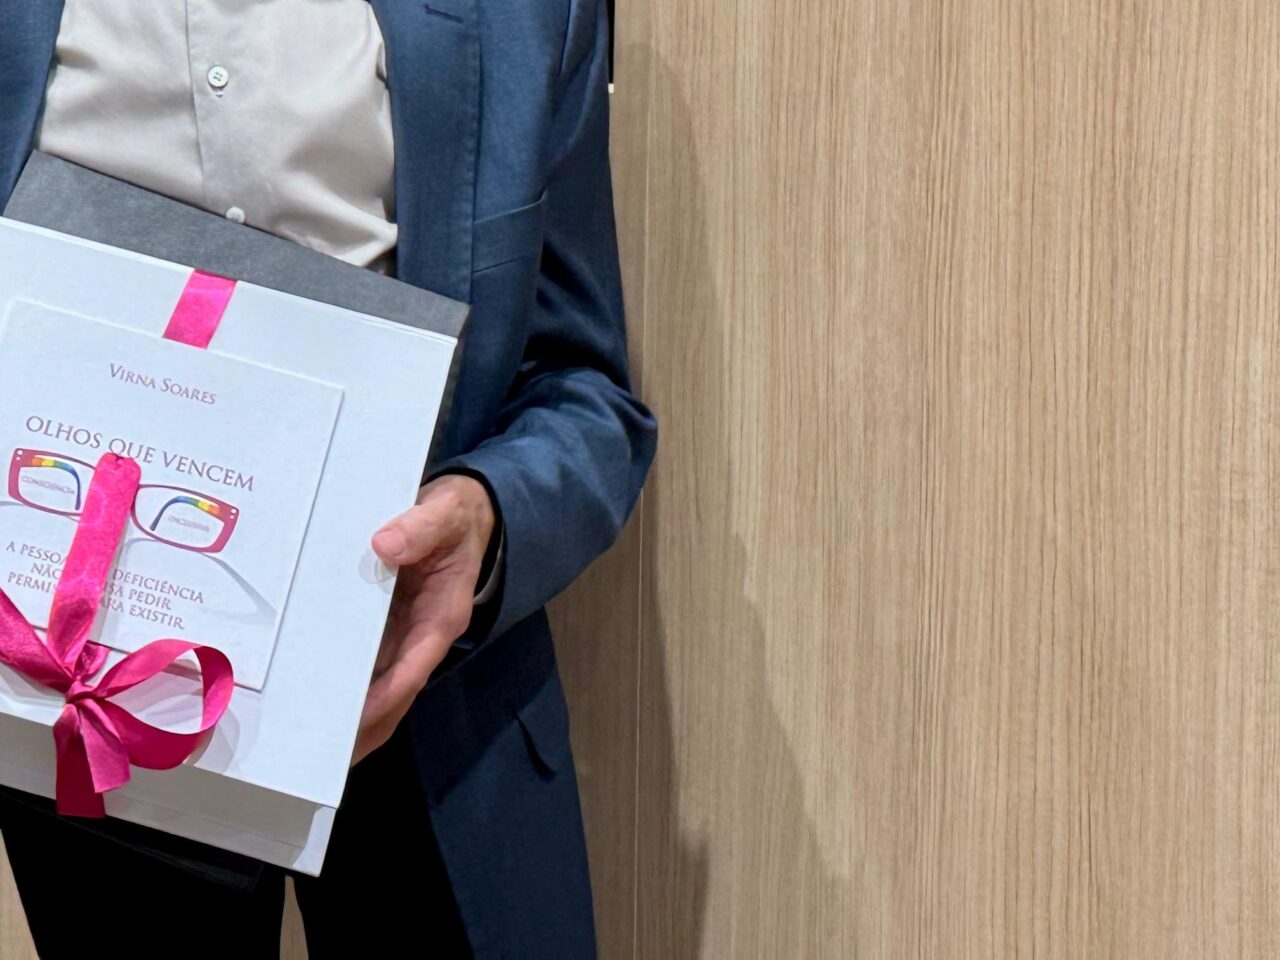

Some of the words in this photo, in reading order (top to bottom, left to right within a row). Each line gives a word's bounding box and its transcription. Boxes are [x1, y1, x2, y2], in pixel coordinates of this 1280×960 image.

[25, 415, 103, 449] OLHOS
[108, 437, 156, 464] QUE
[162, 450, 255, 492] VENCEM
[6, 541, 15, 553] A
[8, 571, 56, 593] PERMI
[99, 596, 124, 613] ARA
[129, 604, 185, 630] EXISTIR
[128, 588, 171, 610] PEDIR
